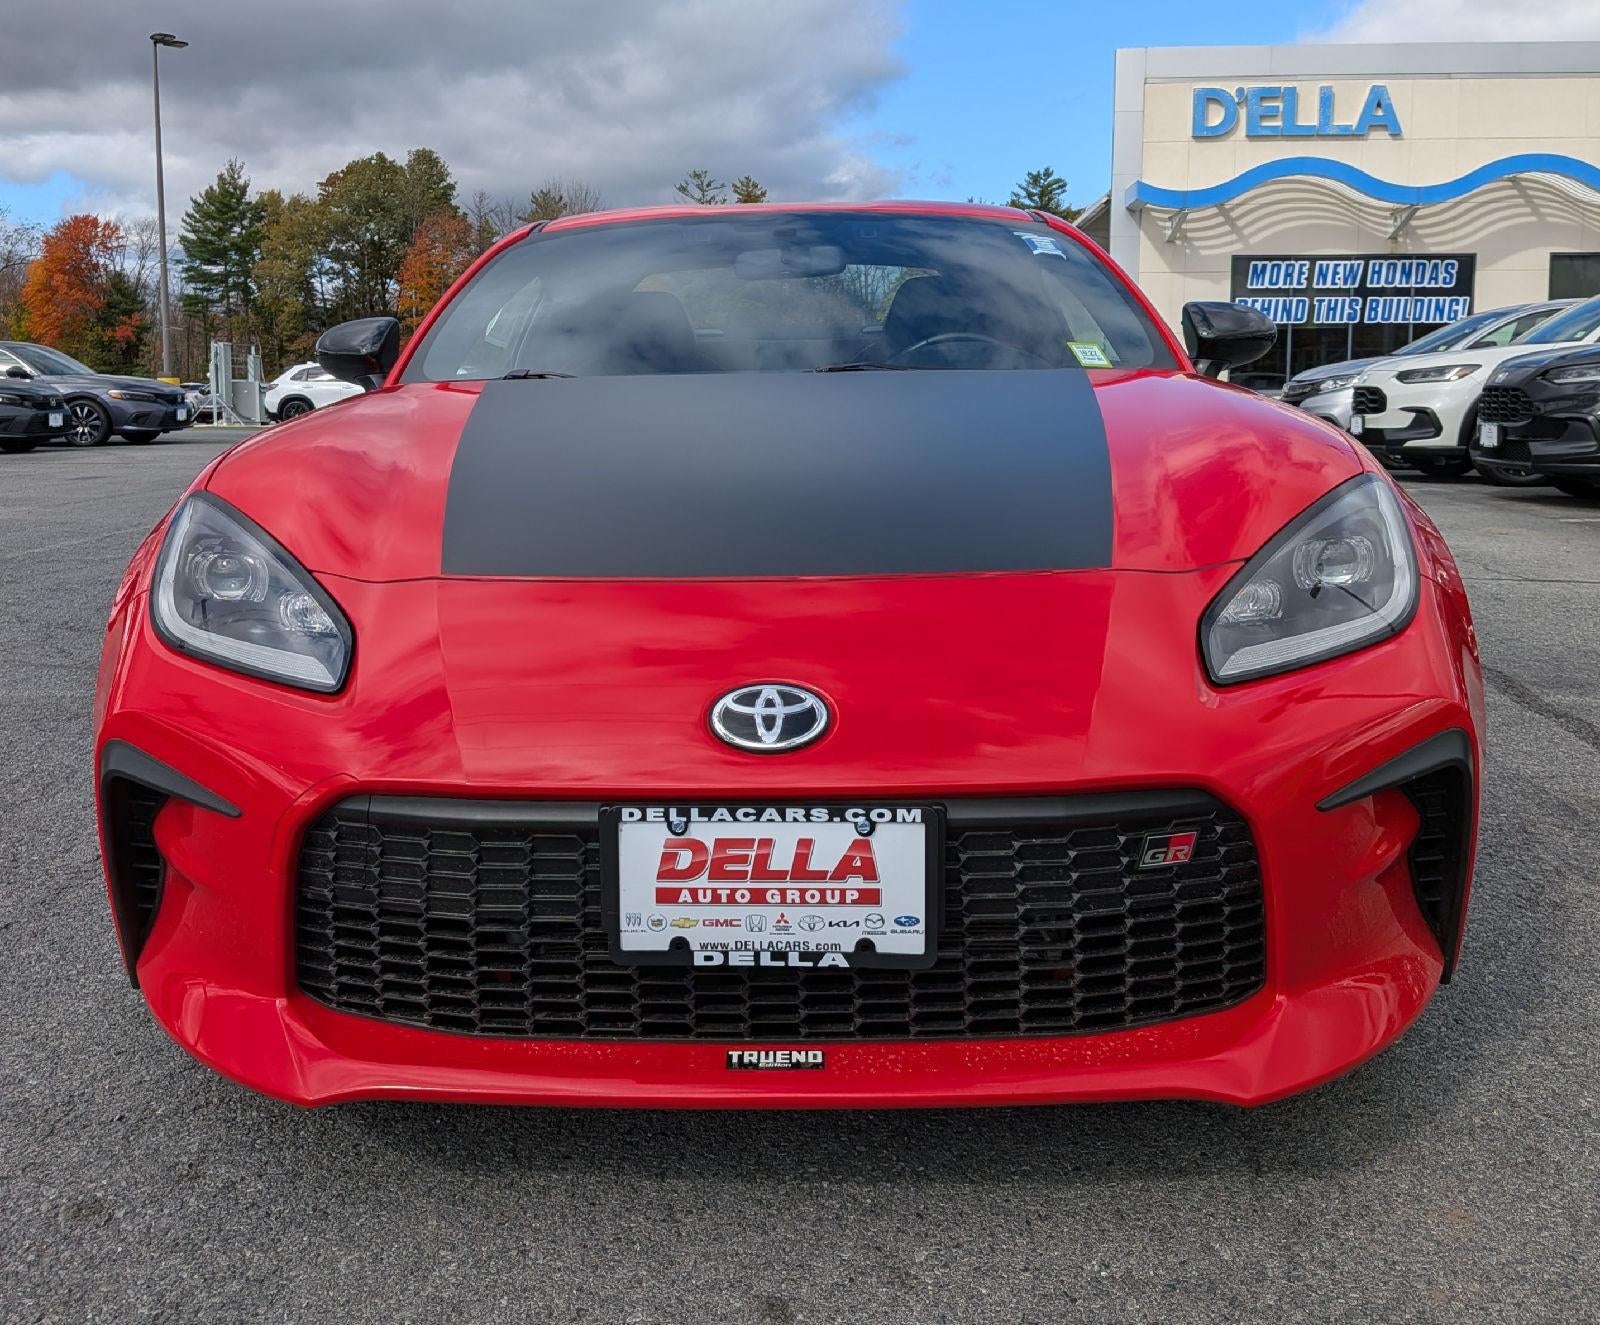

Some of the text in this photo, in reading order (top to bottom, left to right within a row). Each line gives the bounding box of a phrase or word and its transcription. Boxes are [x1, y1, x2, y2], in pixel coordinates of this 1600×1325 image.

[1247, 260, 1458, 288] MORE NEW HONDAS
[1235, 297, 1470, 323] HIND THIS BUILDING!
[621, 807, 922, 823] DELLACARS.COM
[656, 837, 881, 883] DELLA
[1143, 845, 1190, 863] GR
[677, 888, 860, 904] AUTO GROUP
[702, 918, 742, 928] GMC
[699, 940, 842, 951] www.DELLACARS.com
[693, 951, 850, 967] DELLA
[728, 1050, 823, 1063] TRUENO
